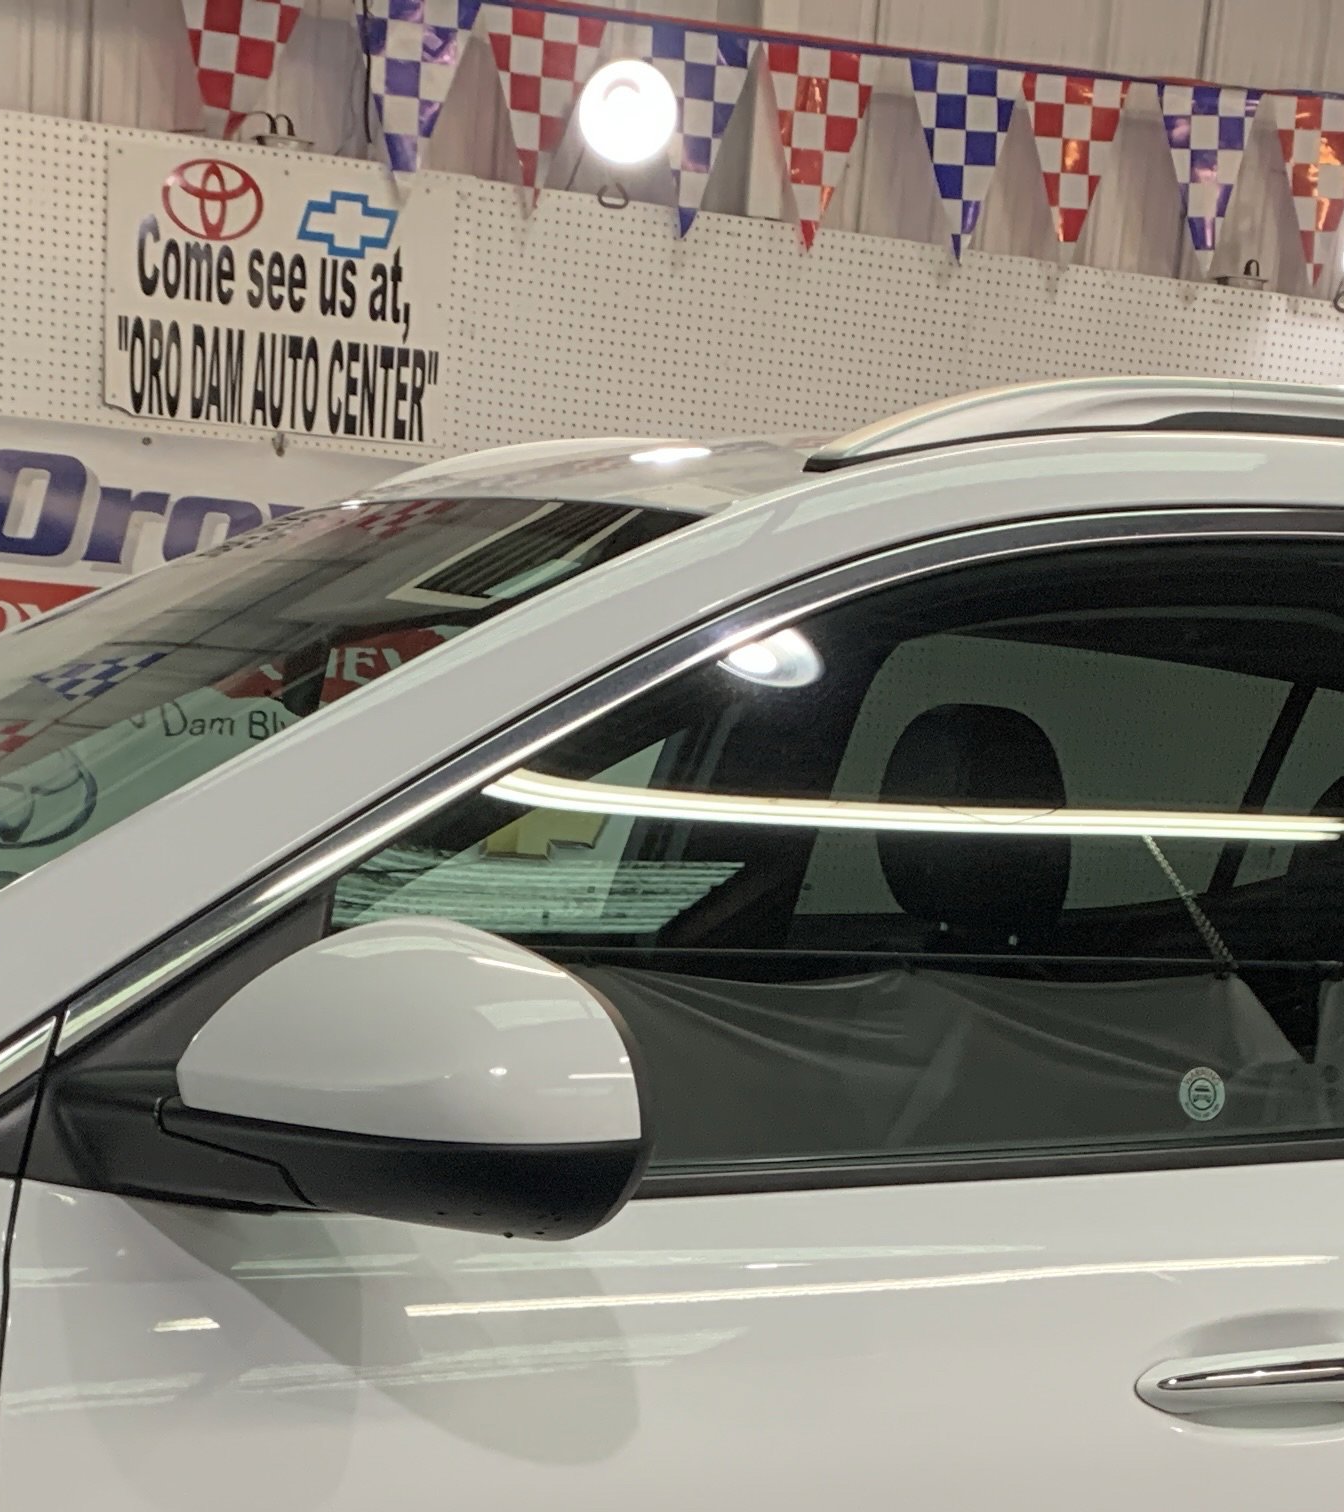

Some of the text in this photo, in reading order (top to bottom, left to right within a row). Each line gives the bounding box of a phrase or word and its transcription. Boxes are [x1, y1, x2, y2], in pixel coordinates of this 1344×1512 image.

[137, 214, 411, 344] Come see us at,
[117, 314, 440, 442] "ORO DAM AUTO CENTER"
[160, 700, 235, 737] Dam
